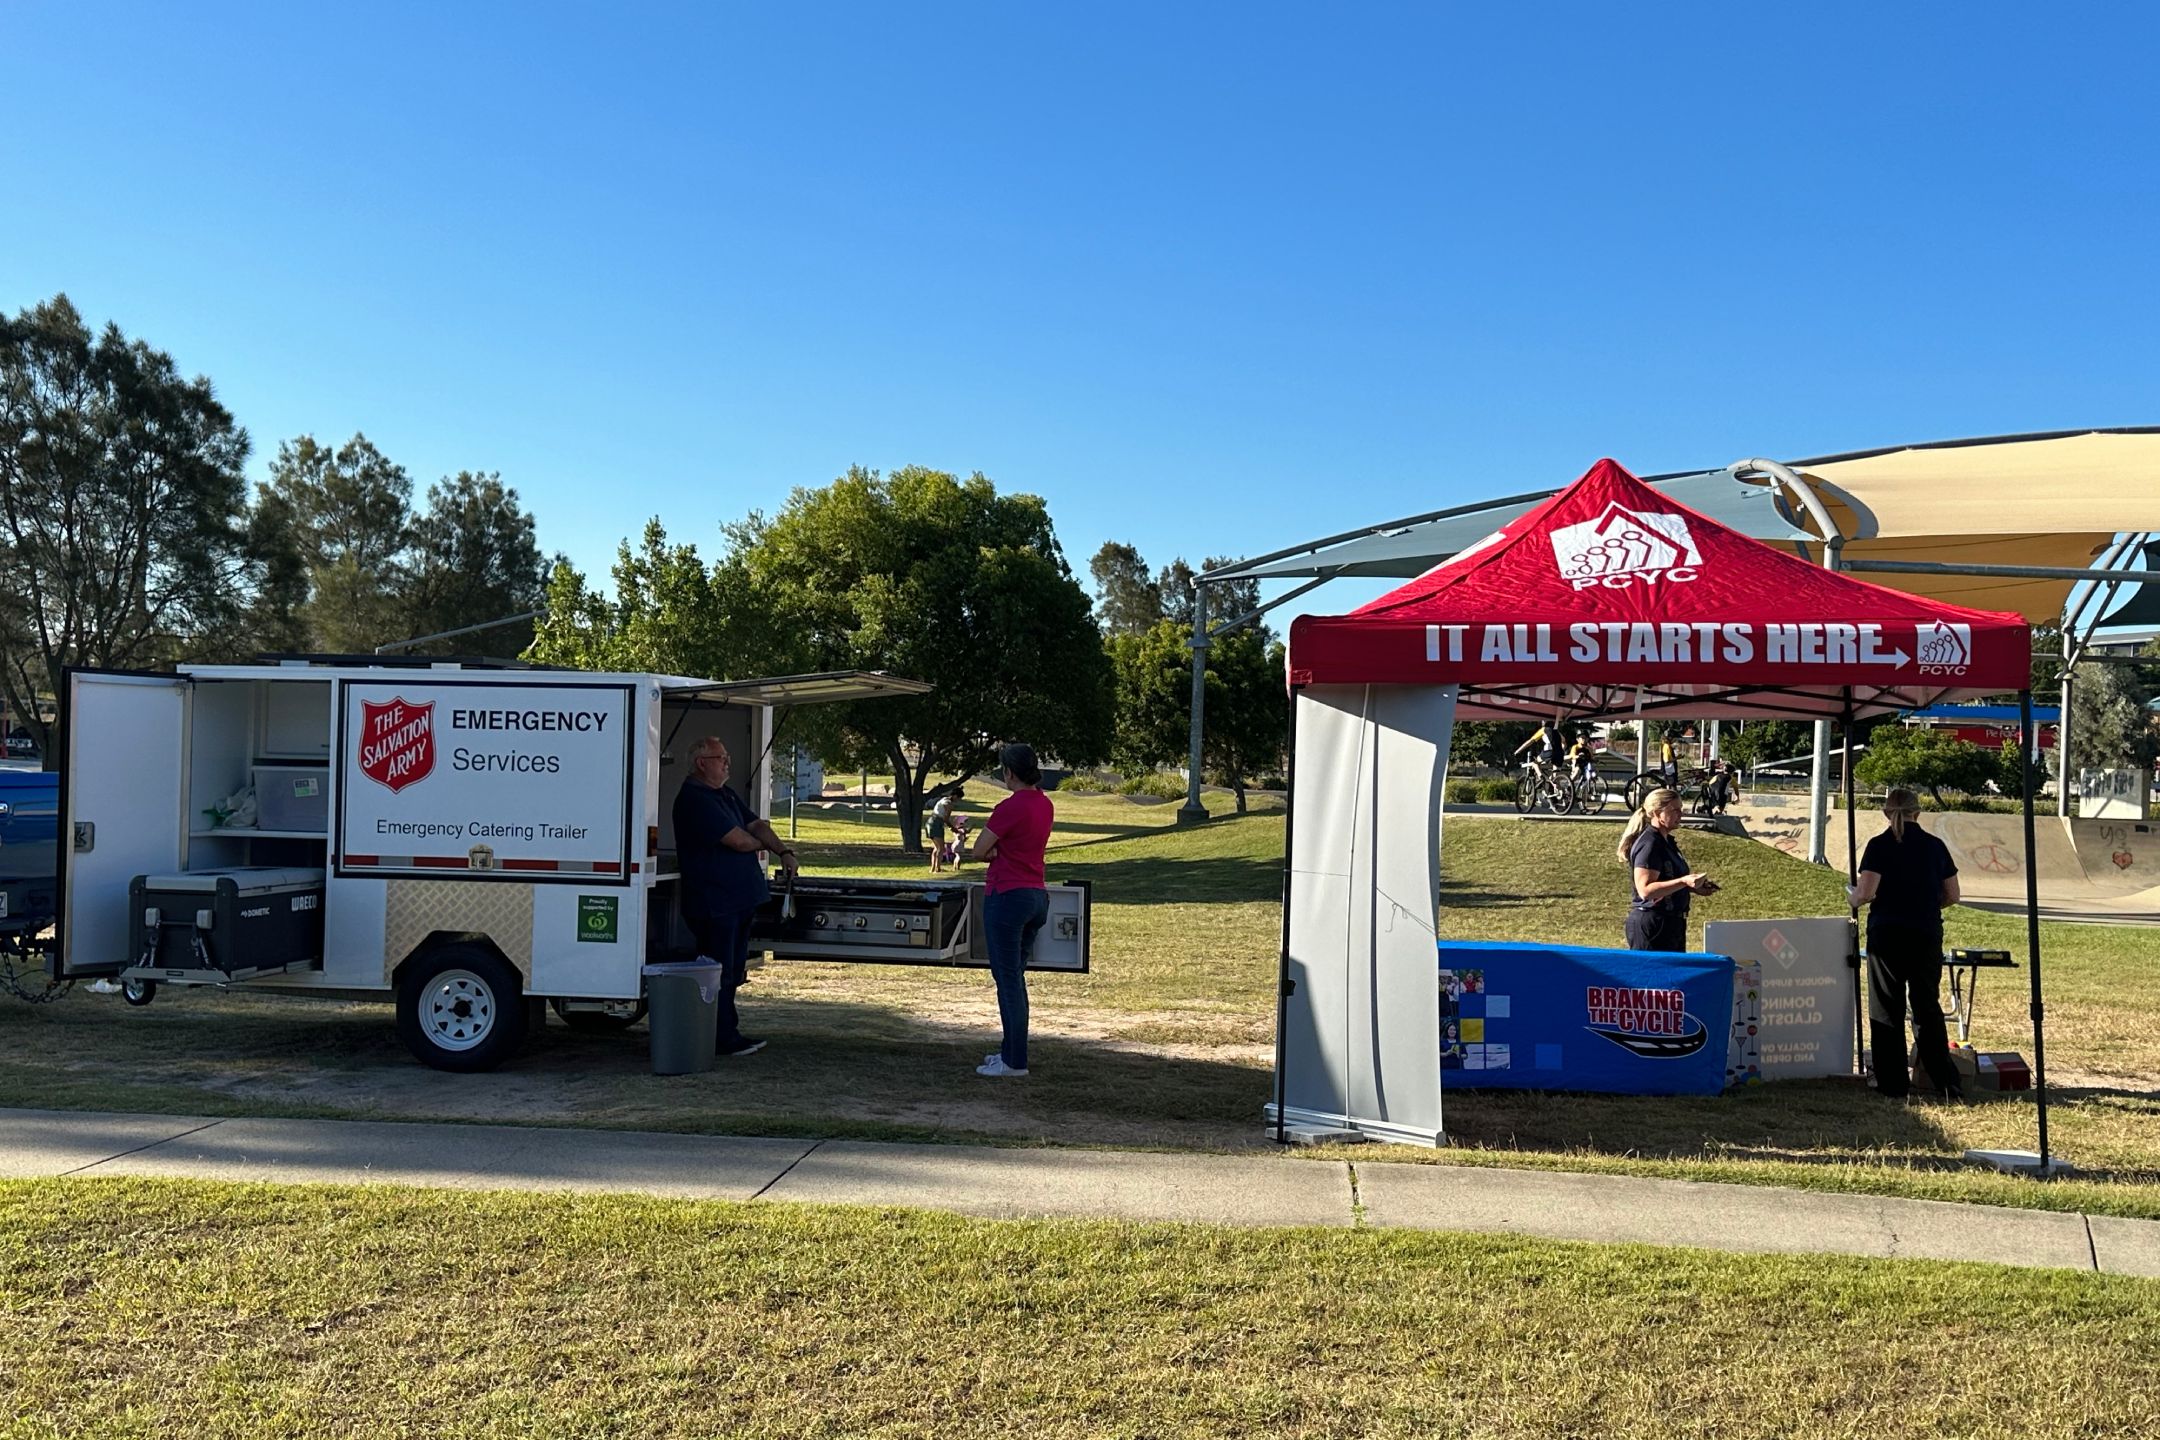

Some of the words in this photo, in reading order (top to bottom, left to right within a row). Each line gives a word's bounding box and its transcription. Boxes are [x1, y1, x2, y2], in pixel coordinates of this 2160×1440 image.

[1572, 567, 1699, 592] PCYC
[1426, 624, 1470, 662] IT
[1480, 623, 1559, 662] ALL
[1569, 622, 1754, 663] STARTS
[1766, 623, 1884, 664] HERE
[1919, 665, 1968, 676] PCYC
[374, 705, 404, 736] THE
[452, 709, 608, 732] EMERGENCY
[363, 710, 431, 769] SALVATION
[386, 738, 427, 782] ARMY
[453, 747, 560, 773] Services
[377, 819, 464, 840] Emergency
[468, 821, 534, 841] Catering
[539, 823, 588, 839] Trailer
[291, 895, 317, 912] WAECO
[1587, 986, 1685, 1012] BRAKING
[1589, 1008, 1617, 1024] THE
[1618, 1009, 1685, 1035] CYCLE
